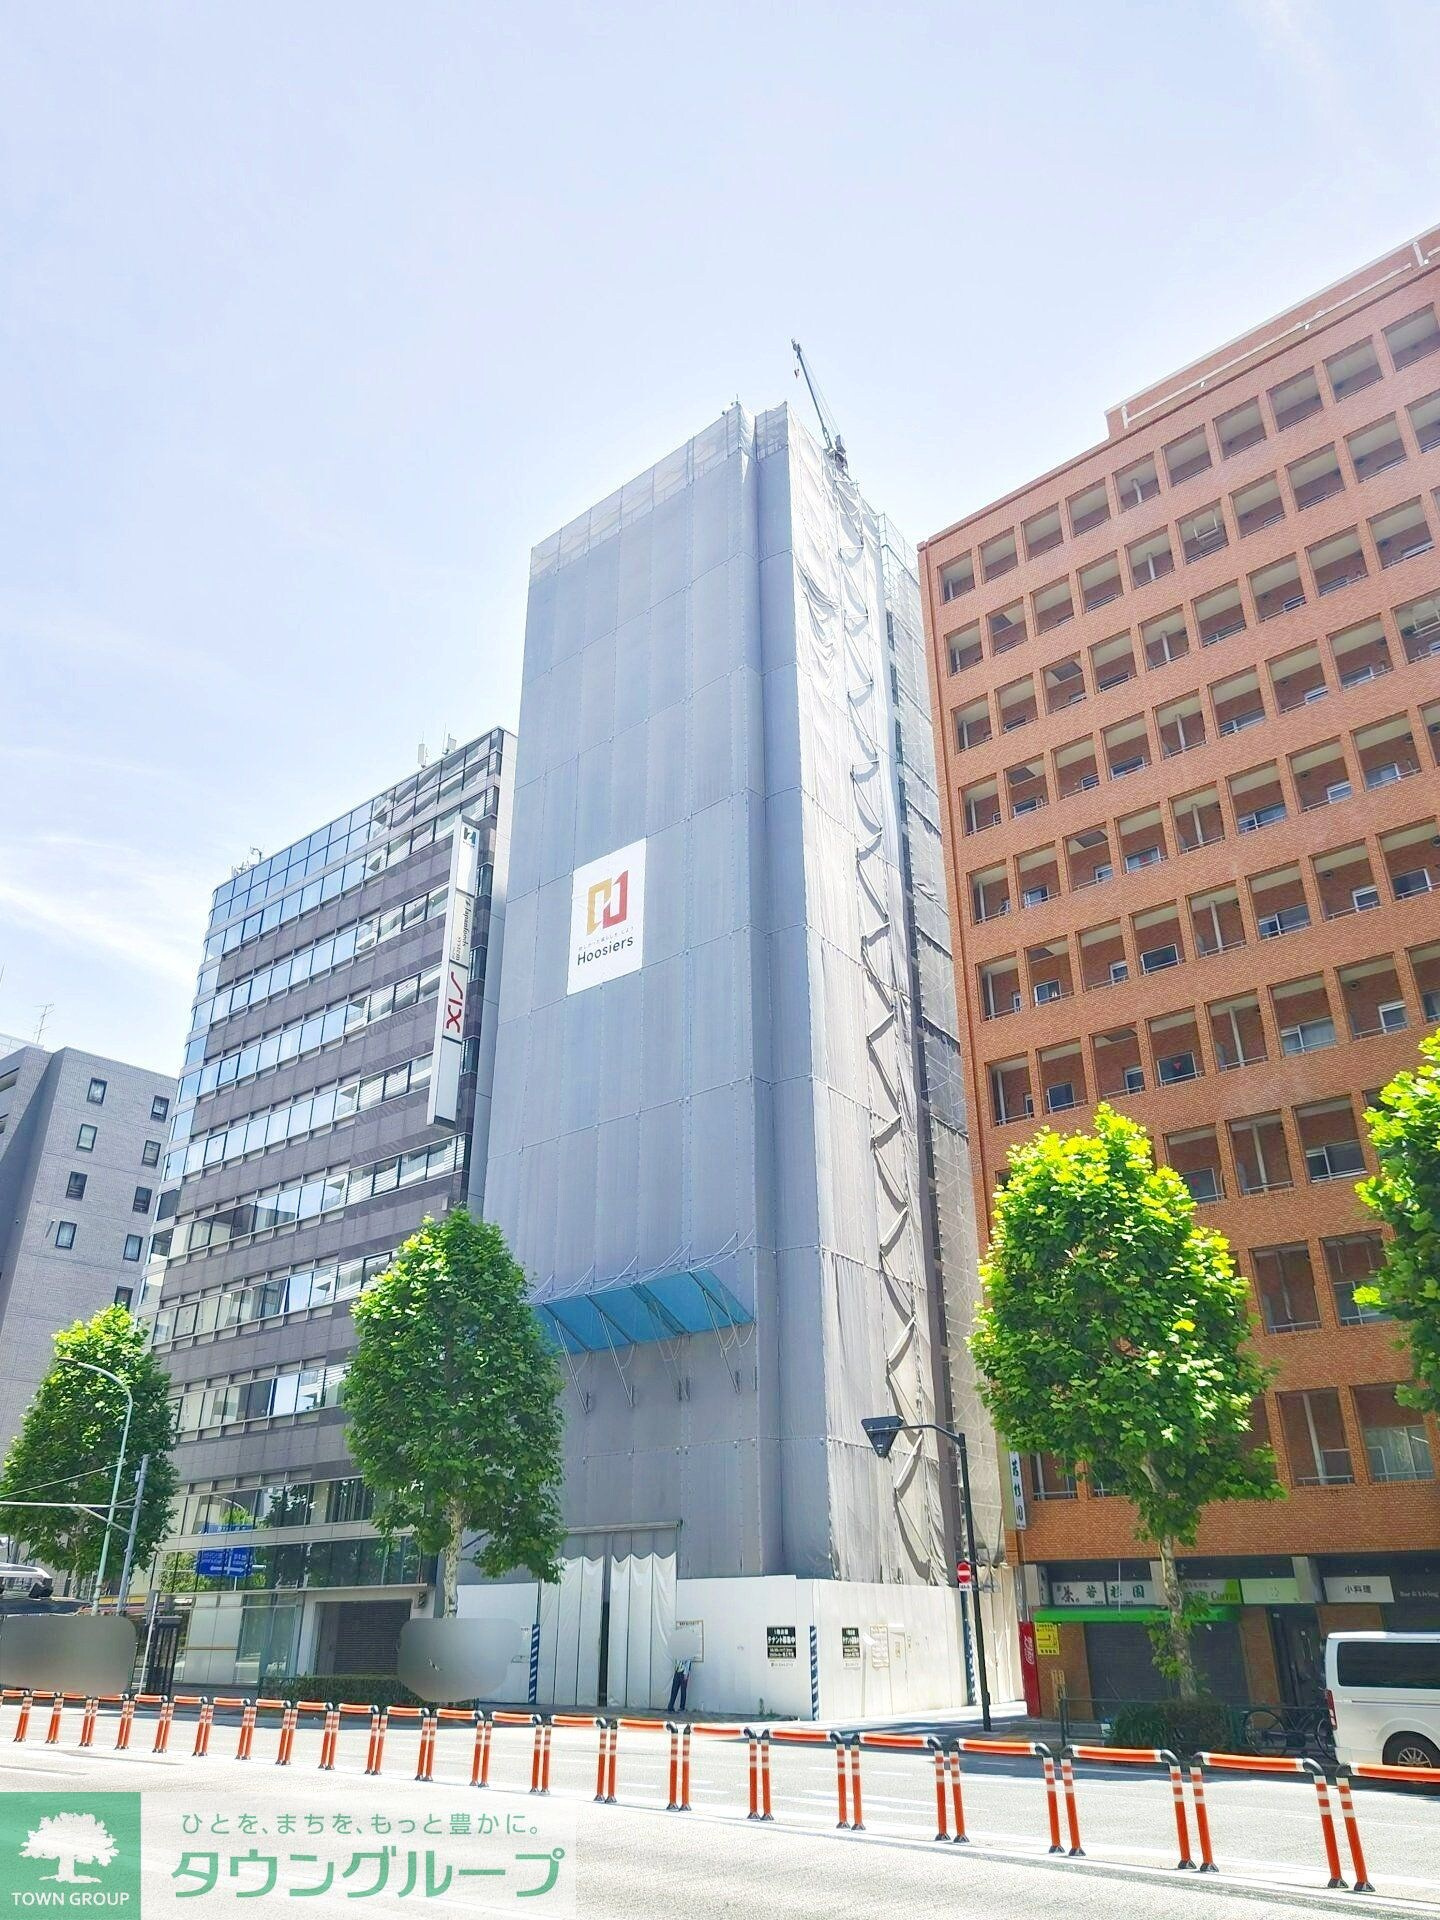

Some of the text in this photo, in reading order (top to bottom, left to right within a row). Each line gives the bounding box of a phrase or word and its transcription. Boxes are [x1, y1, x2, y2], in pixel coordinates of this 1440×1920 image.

[577, 936, 634, 966] Hoosiers
[1344, 1584, 1372, 1594] 小料理
